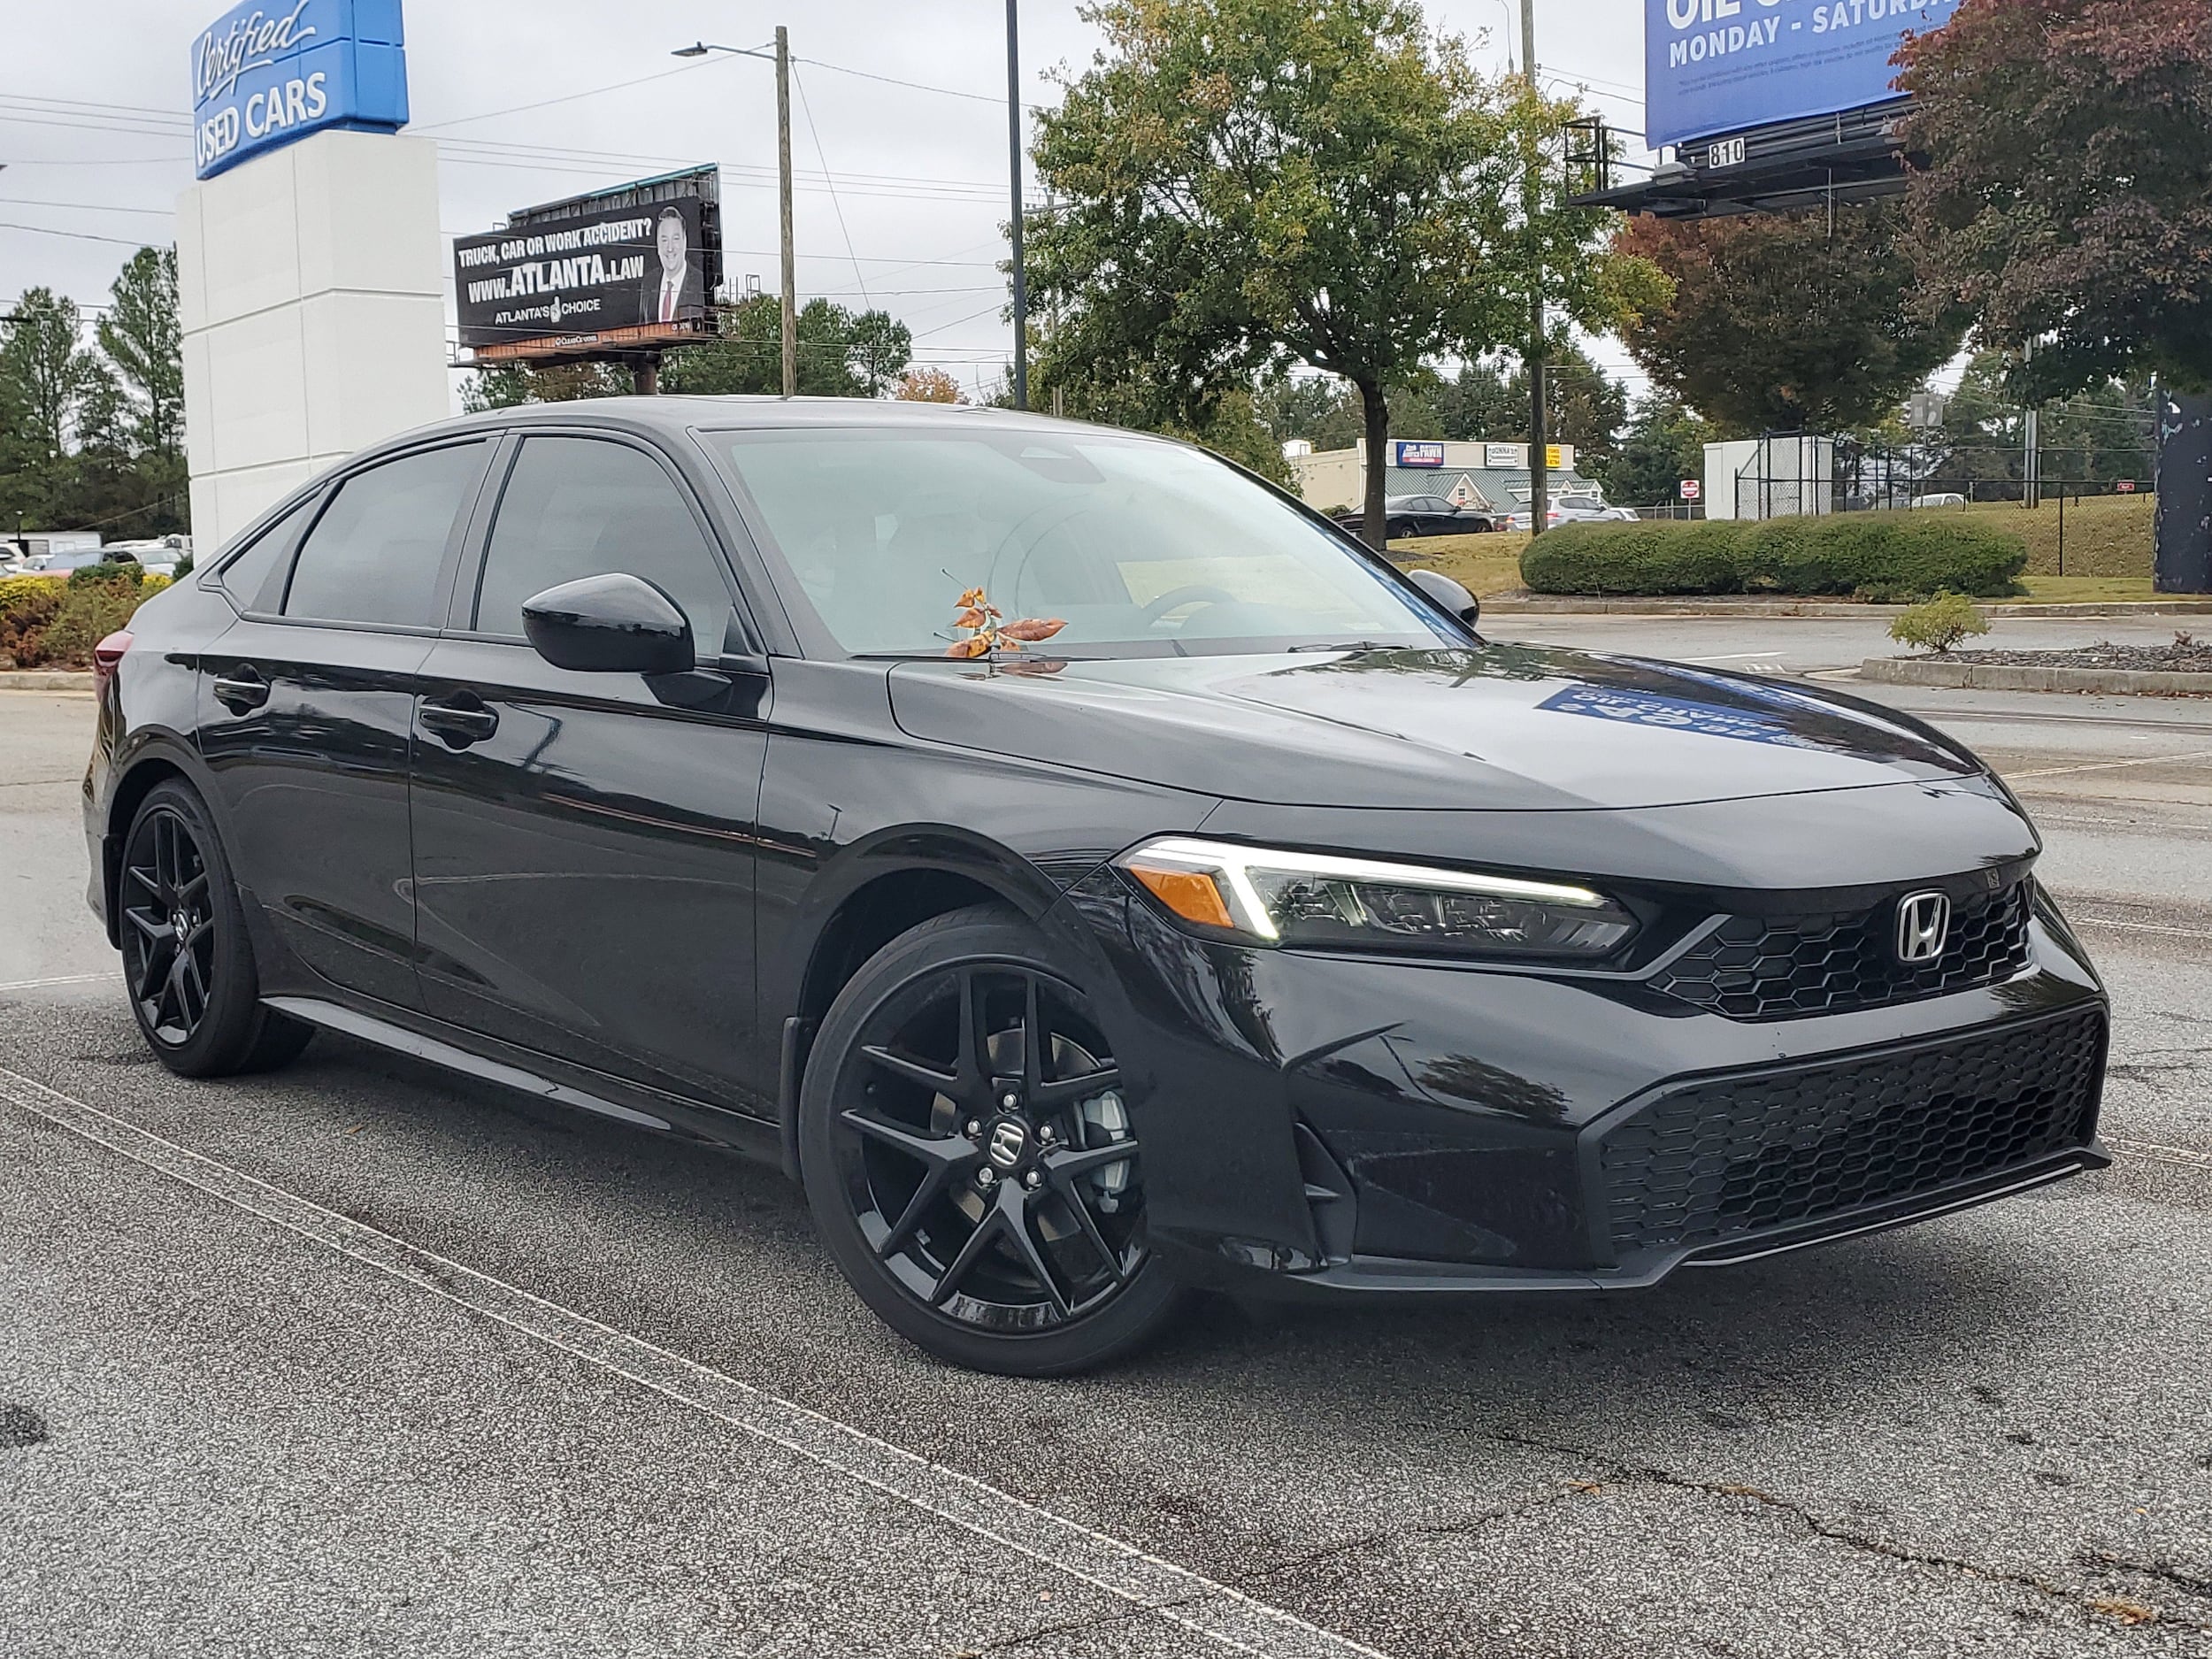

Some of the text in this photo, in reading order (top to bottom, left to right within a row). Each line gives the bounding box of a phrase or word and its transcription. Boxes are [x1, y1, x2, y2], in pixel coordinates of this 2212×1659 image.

[196, 0, 317, 100] Certified
[1670, 16, 1780, 68] MONDAY
[1812, 0, 1949, 34] SATUR
[196, 72, 326, 168] USED CARS
[1710, 141, 1743, 166] 810
[458, 218, 652, 268] TRUCK, CAR OR WORK ACCIDENT?
[495, 298, 602, 325] ATLANTA'S CHOICE
